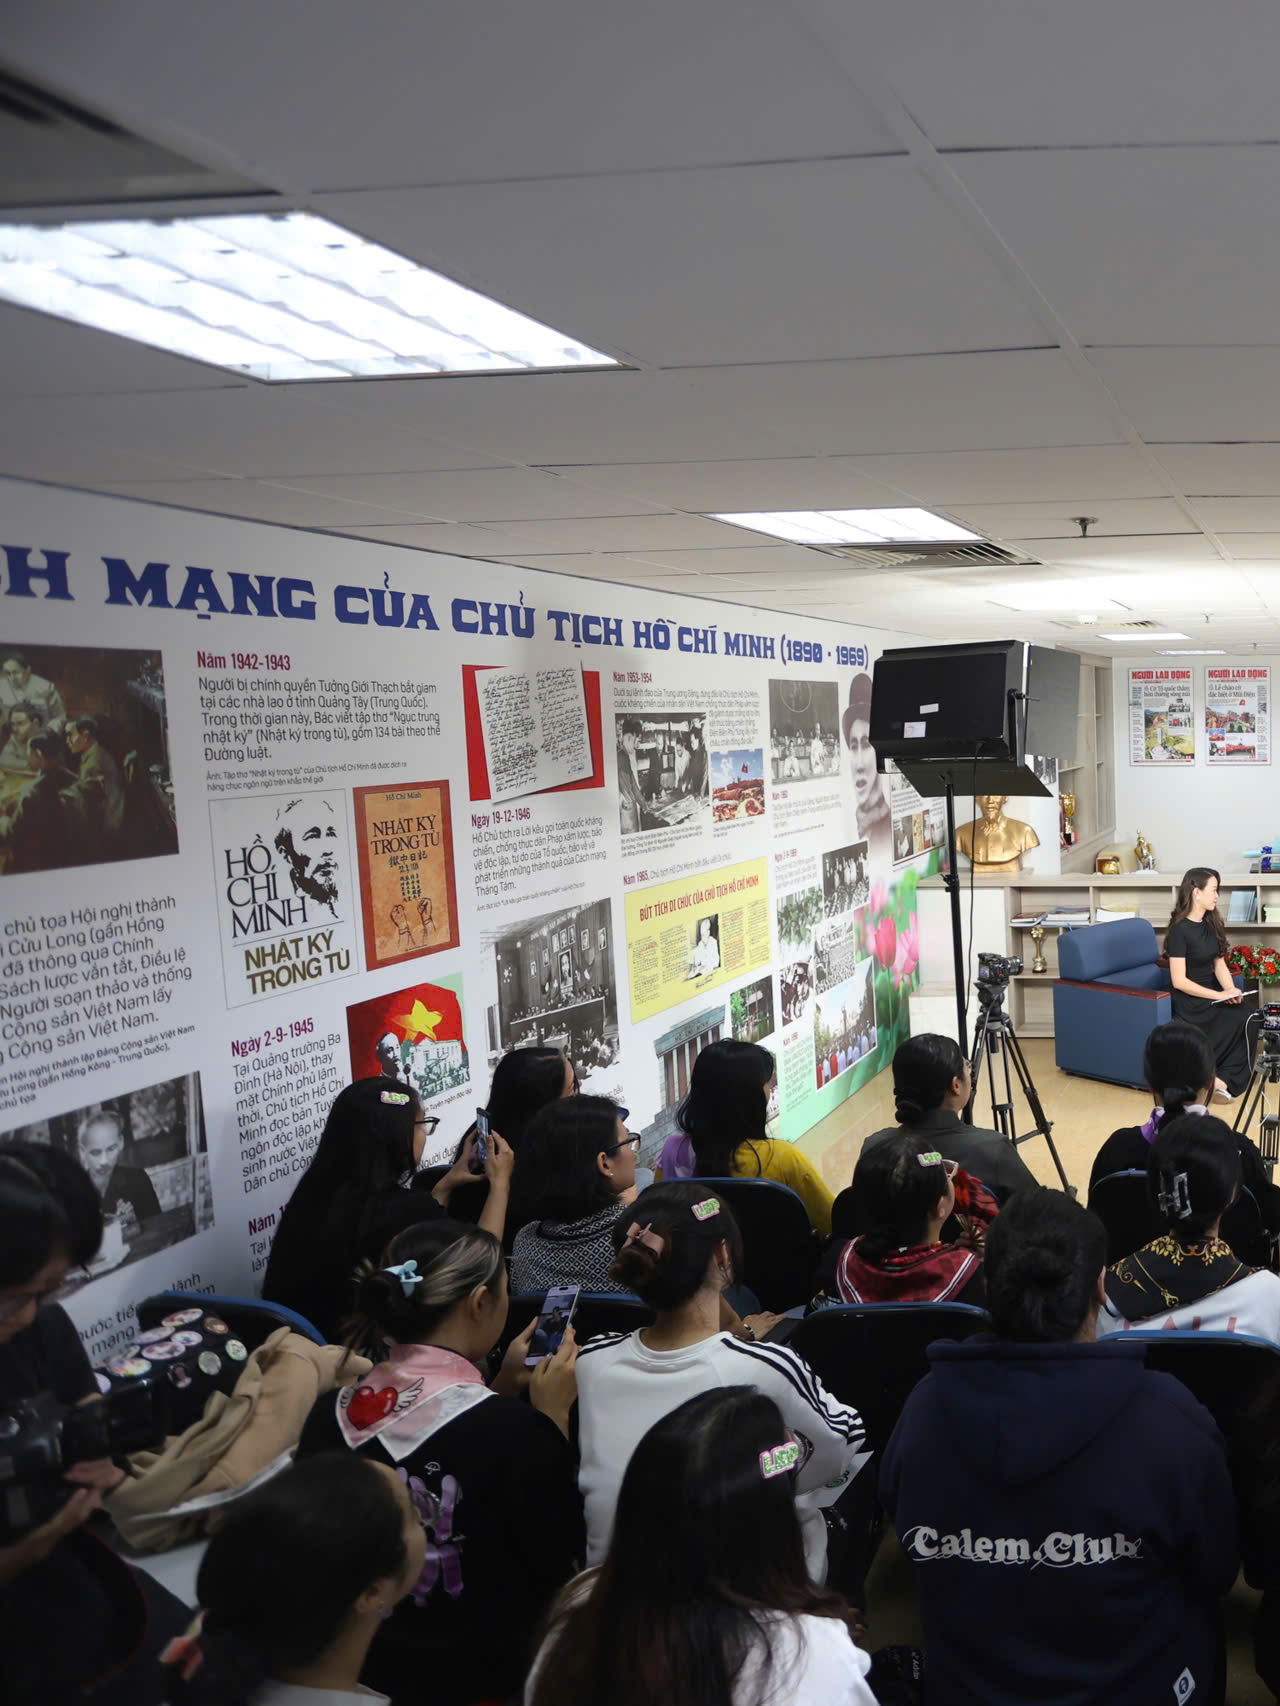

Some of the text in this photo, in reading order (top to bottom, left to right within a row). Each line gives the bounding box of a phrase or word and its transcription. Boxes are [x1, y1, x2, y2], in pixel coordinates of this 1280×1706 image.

[0, 544, 75, 600] H
[101, 556, 316, 621] MẠNG
[334, 570, 440, 631] CỦA
[451, 591, 535, 638] CHỦ
[547, 610, 624, 648] TỊCH
[632, 618, 676, 650] HỒ
[677, 625, 717, 654] CHÍ
[723, 632, 775, 659] MINH
[780, 634, 823, 665] (1890
[835, 643, 868, 668] 1969)
[197, 652, 291, 670] Năm 1942-1943
[1156, 671, 1169, 679] LAO
[1232, 670, 1246, 678] LAO
[199, 678, 437, 695] Người bị chính quyền Tưởng Giới Thạch bắt giam
[201, 696, 216, 710] tại
[219, 696, 240, 708] các
[243, 696, 265, 708] nhà
[268, 696, 283, 708] lao
[296, 695, 315, 708] tỉnh
[318, 695, 350, 711] Quảng
[352, 696, 369, 710] Tây
[371, 697, 399, 709] (Trung
[401, 695, 428, 708] Quốc).
[202, 713, 237, 727] Trong
[240, 712, 262, 725] thời
[265, 714, 288, 727] gian
[291, 713, 312, 727] này,
[314, 712, 333, 724] Bác
[335, 710, 353, 723] viết
[355, 712, 370, 725] tập
[373, 712, 387, 723] thơ
[418, 713, 439, 725] trung
[203, 730, 231, 744] nhật
[257, 729, 286, 744] (Nhật
[289, 728, 301, 742] ký
[304, 729, 331, 742] trong
[333, 727, 350, 741] tù),
[352, 725, 373, 740] gồm
[375, 727, 389, 738] 134
[392, 726, 404, 737] bài
[407, 726, 425, 736] theo
[427, 722, 440, 736] thể
[205, 747, 272, 762] Đường luật.
[224, 833, 272, 880] HỒ
[227, 865, 279, 907] CHÍ
[4, 896, 176, 936] chủ tọa Hội nghị thành
[231, 896, 309, 938] MINH
[8, 918, 164, 956] Cửu Long (gần Hồng
[244, 928, 334, 971] NHẬT KÝ
[3, 937, 153, 978] đã thông qua Chính
[246, 947, 350, 995] TRONG TÙ
[231, 1017, 314, 1057] Ngày 2-9-1945
[234, 1033, 341, 1078] Tại Quảng trường Ba
[234, 1051, 334, 1095] Đình (Hà Nội), thay
[236, 1066, 337, 1112] mặt Chính phủ lâm
[237, 1076, 345, 1128] thời, Chủ tịch Hồ Chí
